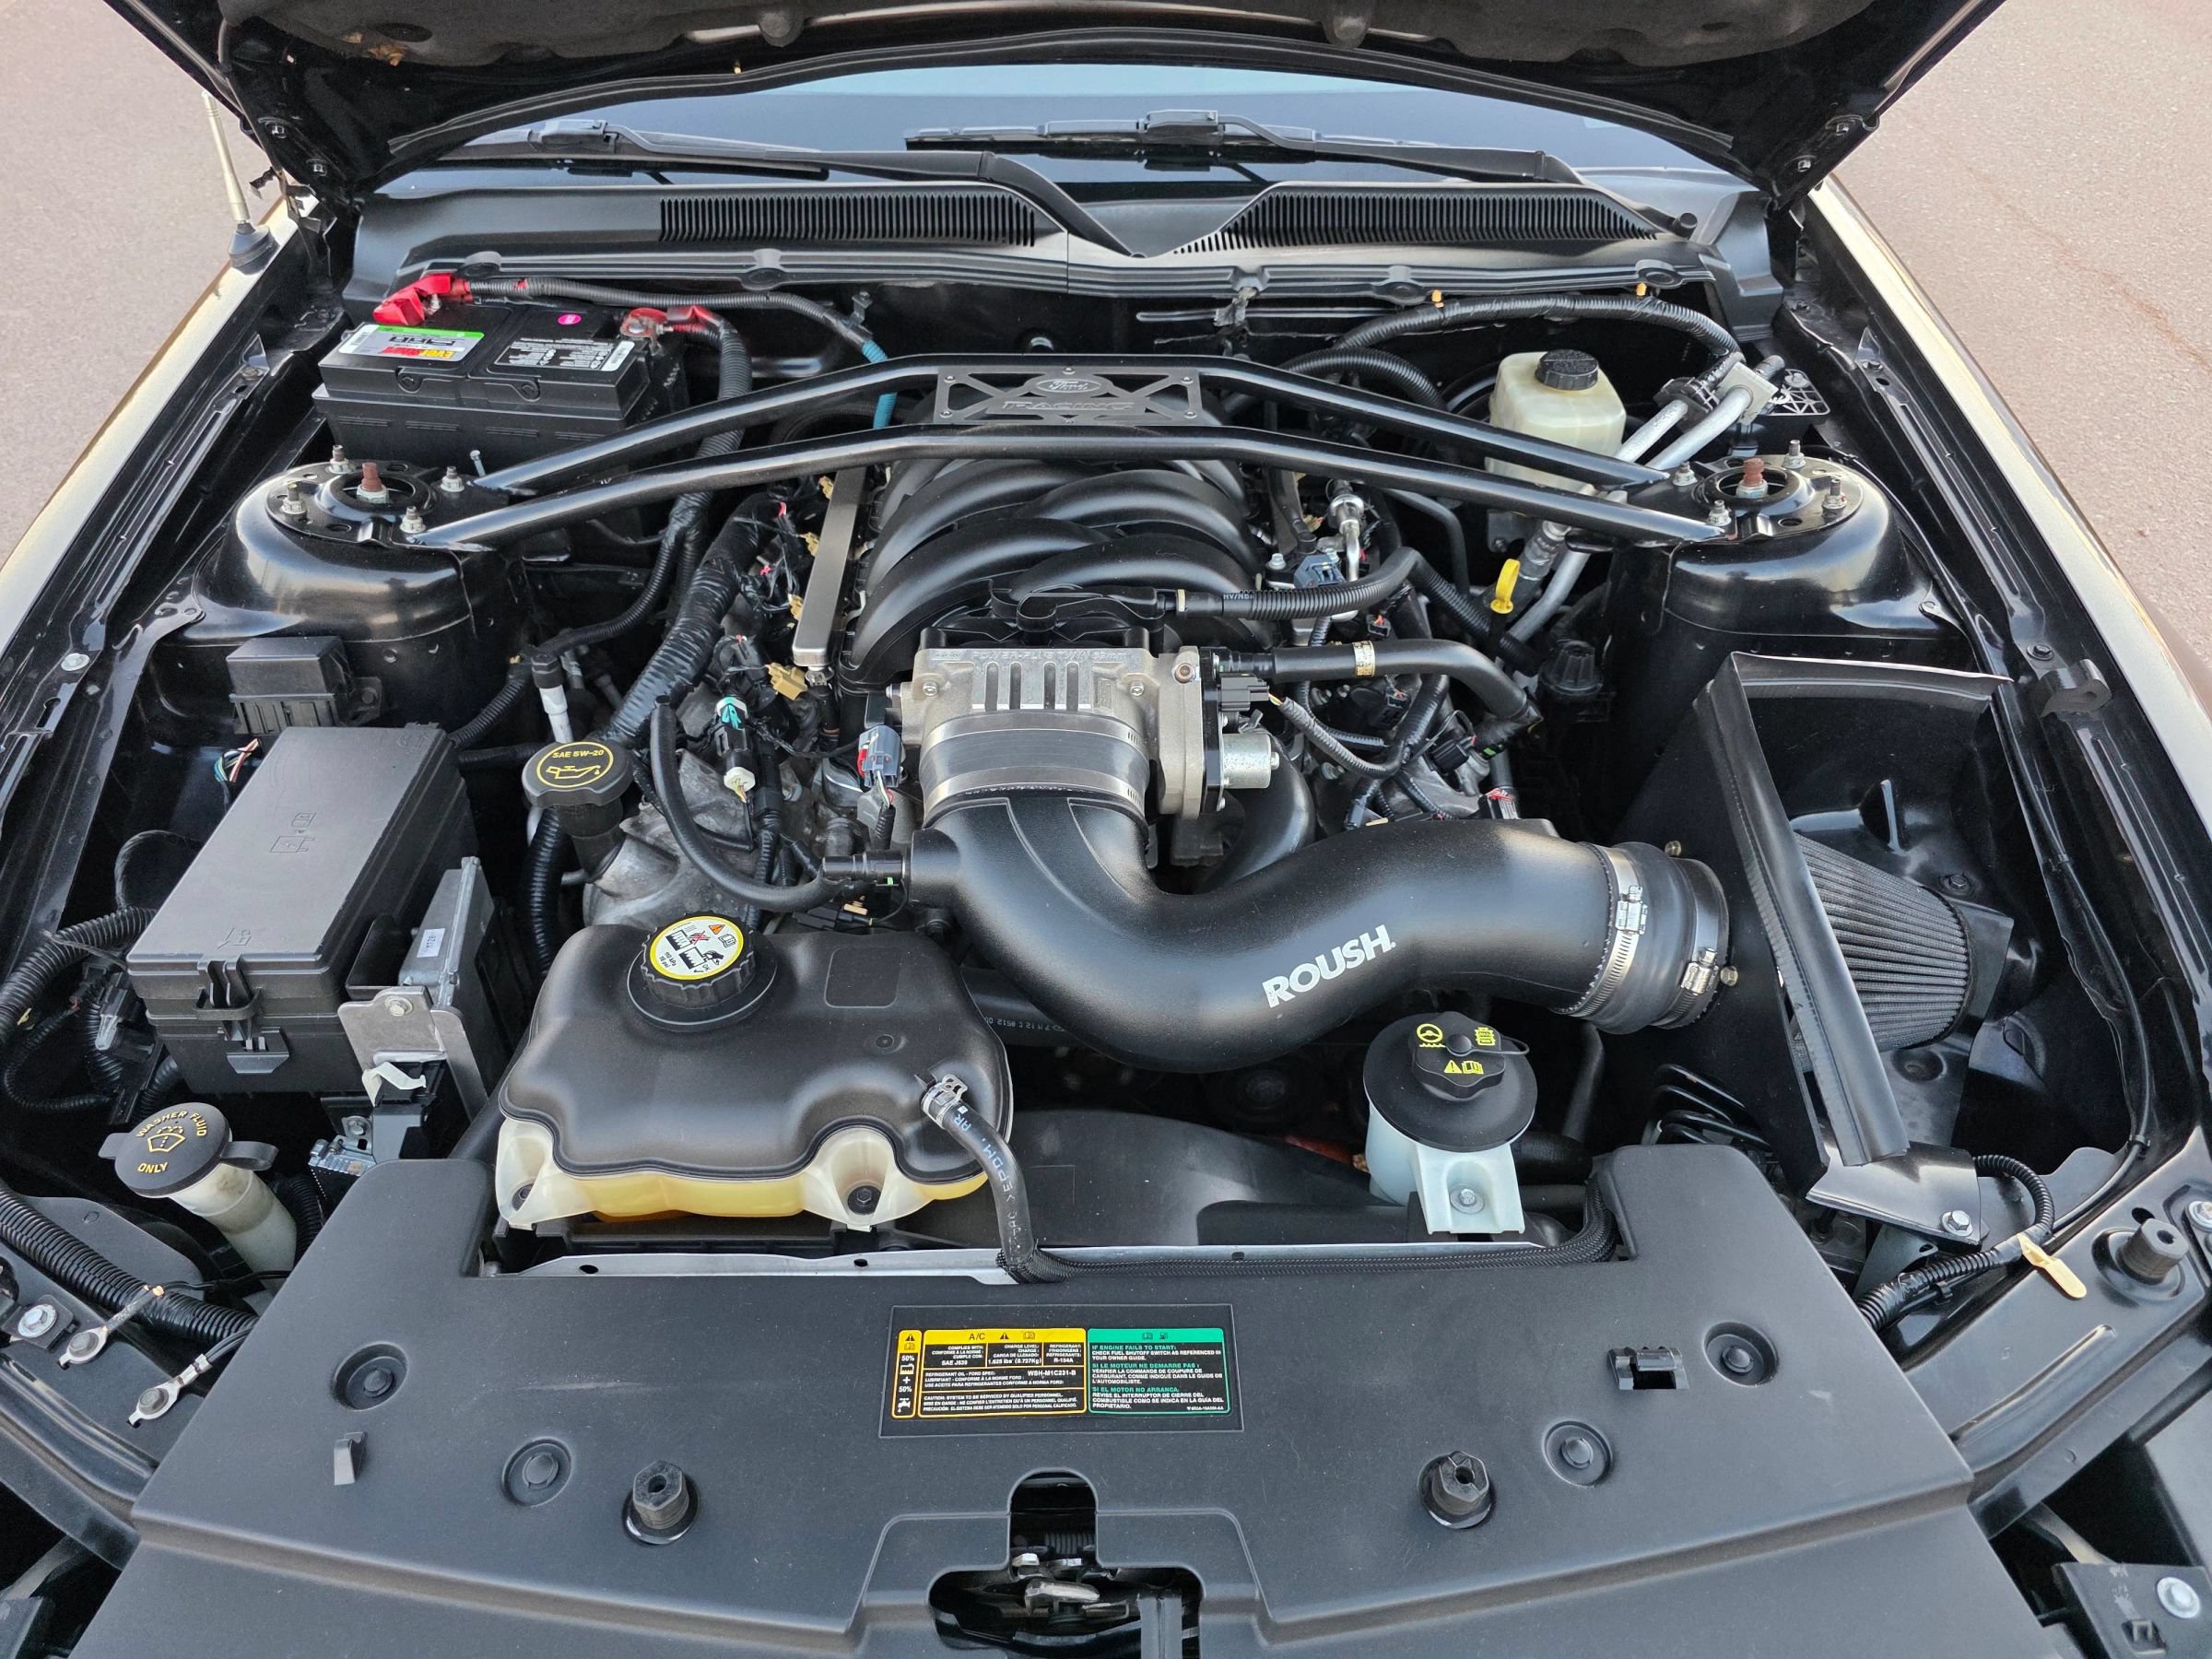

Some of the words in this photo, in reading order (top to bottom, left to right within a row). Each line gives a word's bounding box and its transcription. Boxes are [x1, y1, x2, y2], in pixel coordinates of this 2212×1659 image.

[1049, 380, 1088, 390] Ford
[1003, 401, 1135, 410] RACING
[571, 749, 605, 758] 5W-20
[1262, 924, 1393, 1008] ROUSH
[136, 1111, 188, 1137] WASHER
[189, 1112, 208, 1136] FLUID
[137, 1161, 169, 1173] ONLY
